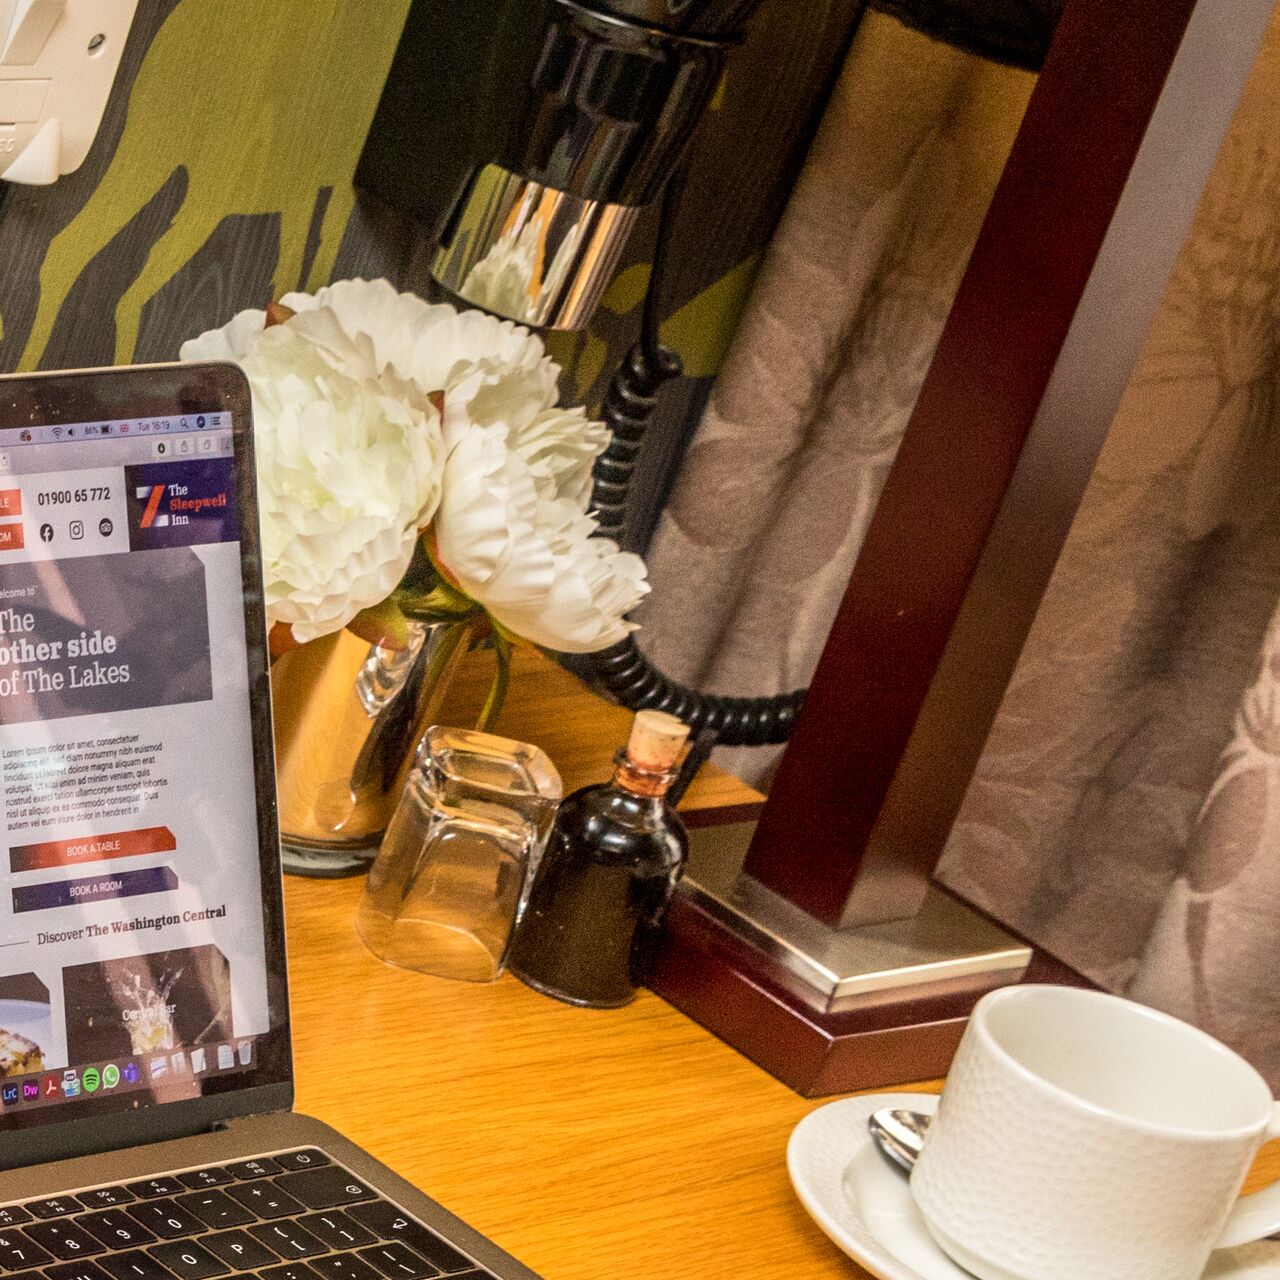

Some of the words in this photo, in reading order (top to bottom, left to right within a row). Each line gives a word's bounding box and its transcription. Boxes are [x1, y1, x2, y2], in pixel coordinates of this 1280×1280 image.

[38, 490, 71, 506] 01900
[74, 489, 88, 502] 65
[90, 487, 111, 501] 772
[168, 484, 188, 496] The
[170, 494, 226, 513] Sleepwell
[171, 514, 189, 526] Inn
[25, 586, 36, 597] to
[67, 631, 117, 658] side
[23, 667, 65, 692] The
[69, 662, 130, 688] Lakes
[66, 845, 88, 857] BOOK
[89, 844, 95, 854] A
[95, 840, 121, 854] TABLE
[70, 885, 91, 897] BOOK
[92, 883, 99, 894] A
[99, 880, 123, 894] ROOM
[37, 927, 84, 946] Discover
[85, 925, 110, 938] The
[112, 914, 181, 934] Washington
[182, 904, 227, 923] Central
